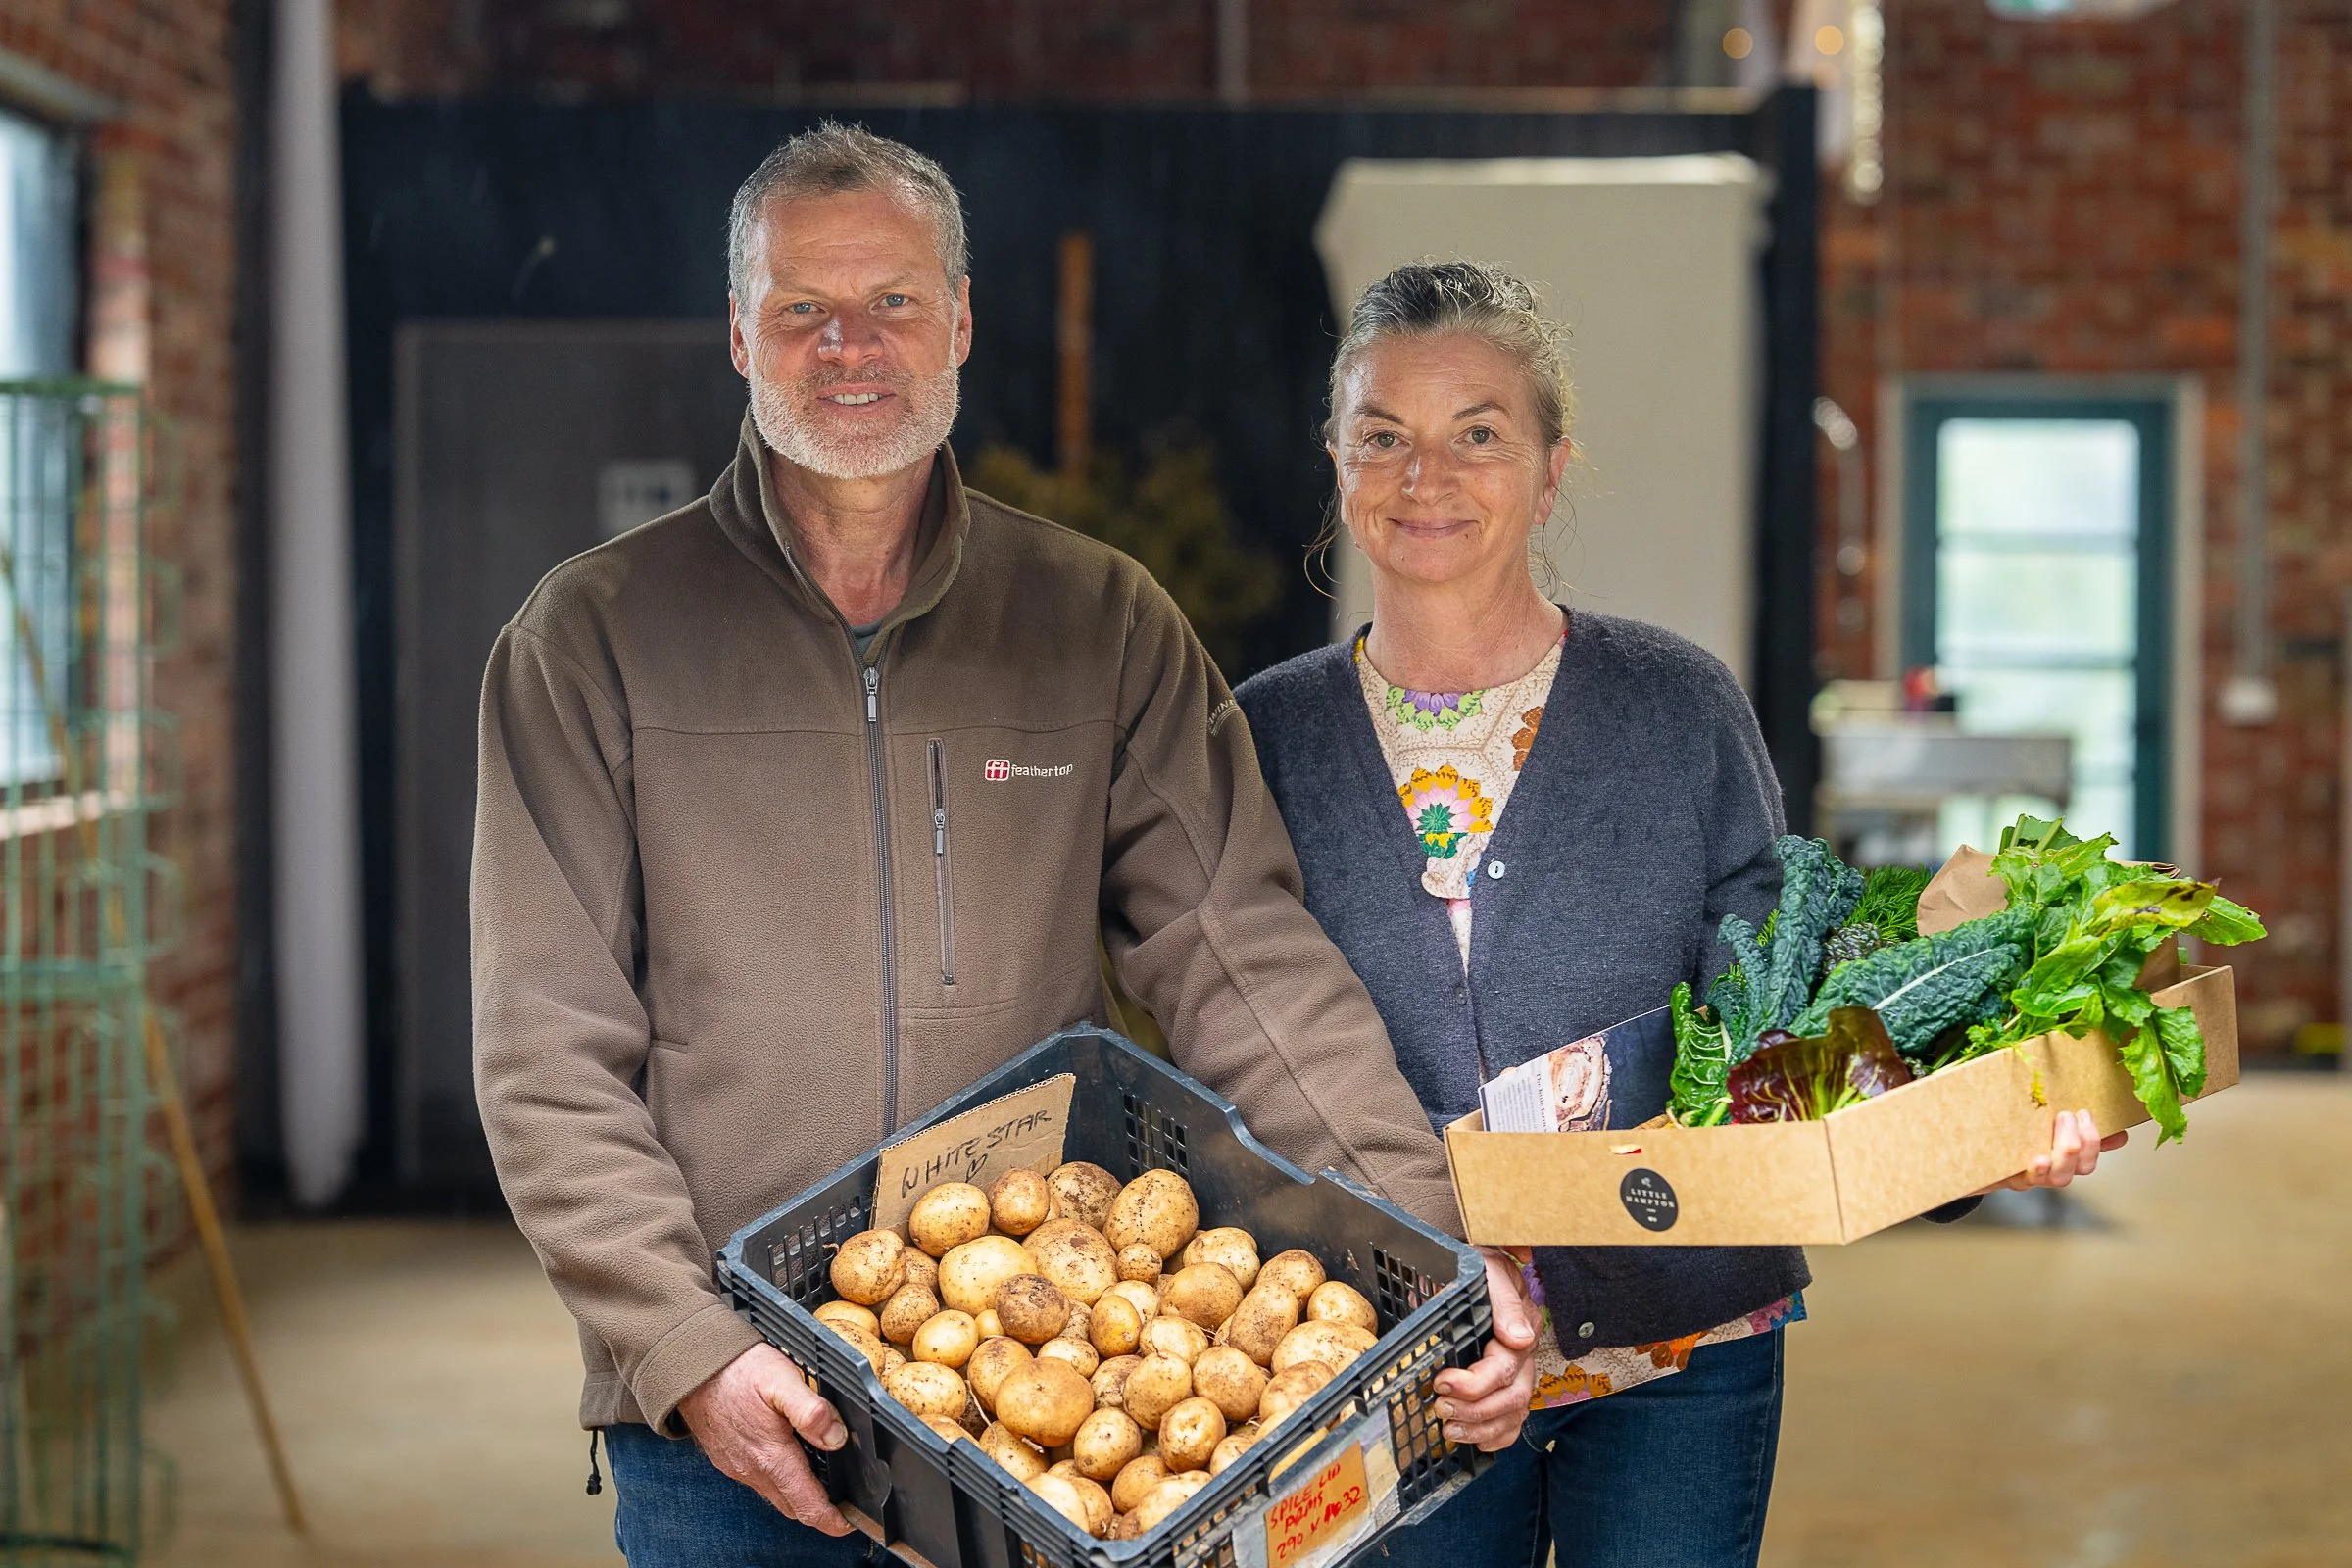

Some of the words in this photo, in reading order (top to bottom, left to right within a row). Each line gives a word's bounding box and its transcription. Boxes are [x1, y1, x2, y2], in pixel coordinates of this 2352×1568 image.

[1011, 764, 1073, 777] feathertop
[986, 1109, 1052, 1149] STAR
[1630, 1188, 1667, 1200] LITTLE
[1625, 1196, 1675, 1208] HAMPTON
[1276, 1532, 1303, 1560] 290
